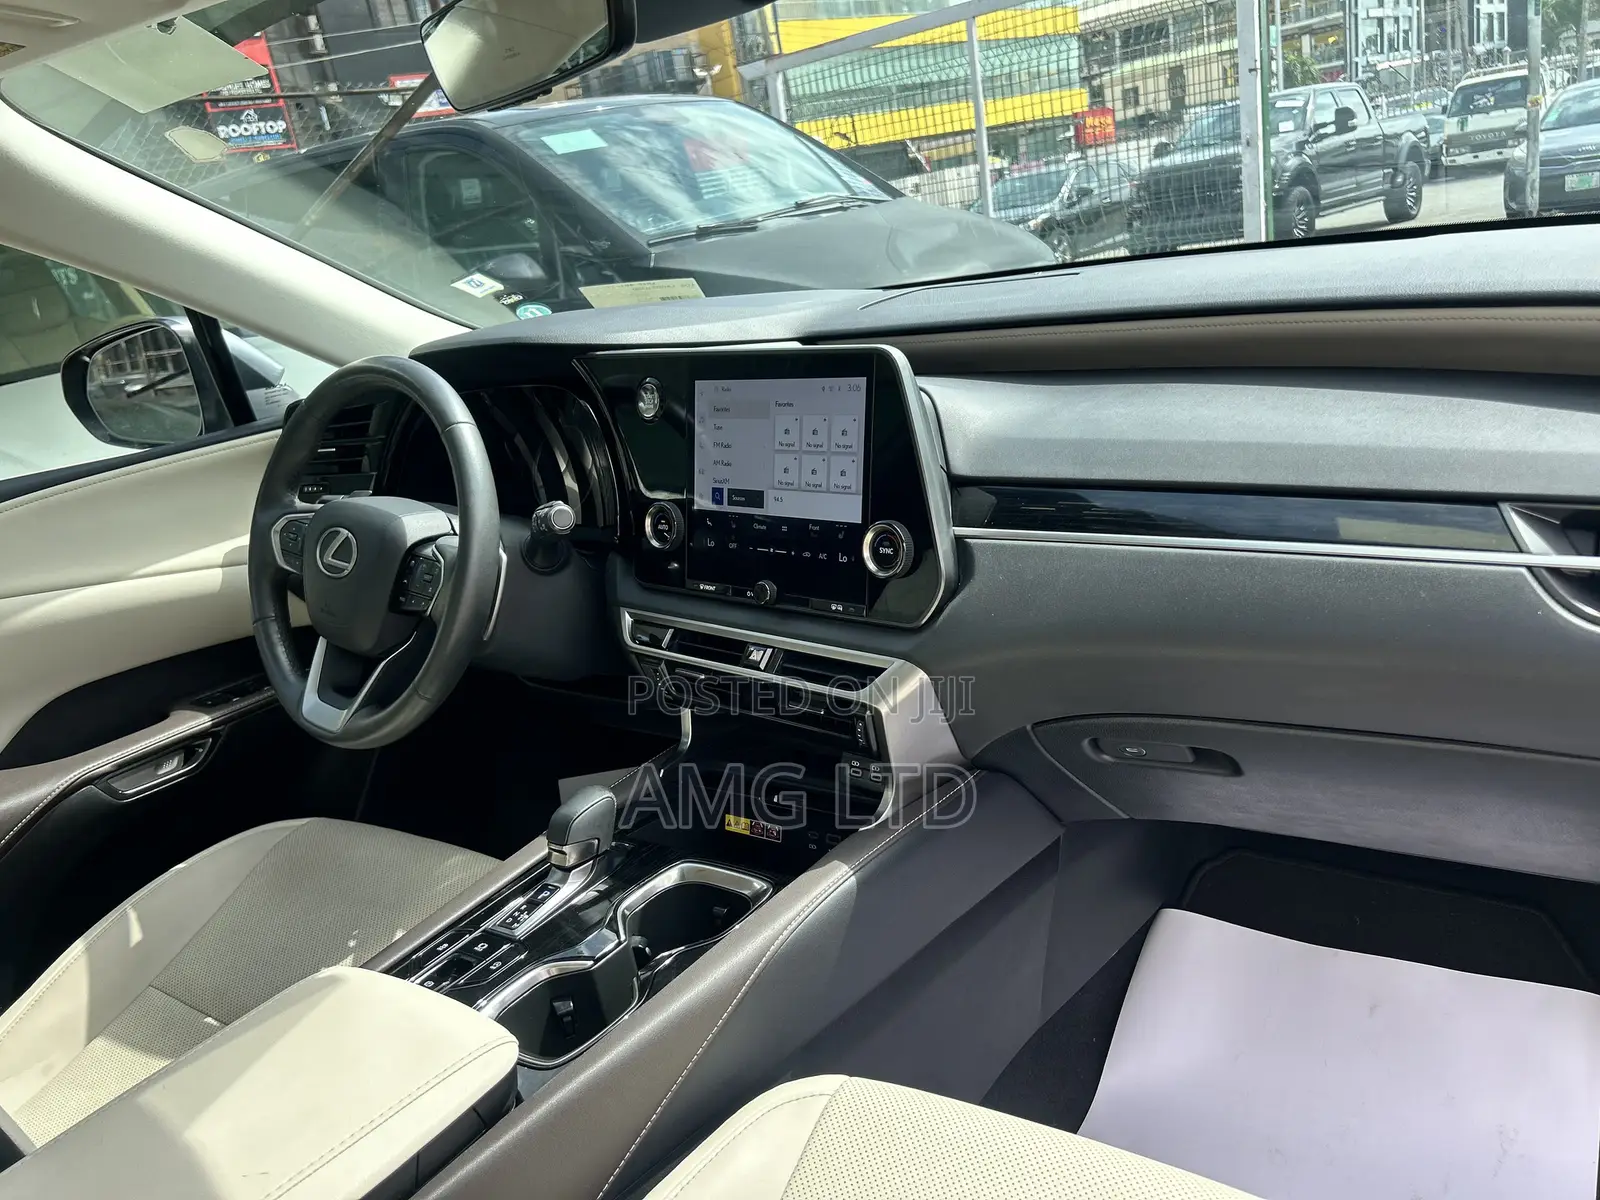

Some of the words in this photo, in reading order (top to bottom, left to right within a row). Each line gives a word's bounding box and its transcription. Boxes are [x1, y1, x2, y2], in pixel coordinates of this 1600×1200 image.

[216, 120, 286, 138] ROOFTOP
[1470, 130, 1506, 141] TOYOTA
[847, 384, 861, 392] 3:06
[708, 538, 715, 547] Lo
[838, 552, 848, 562] Lo
